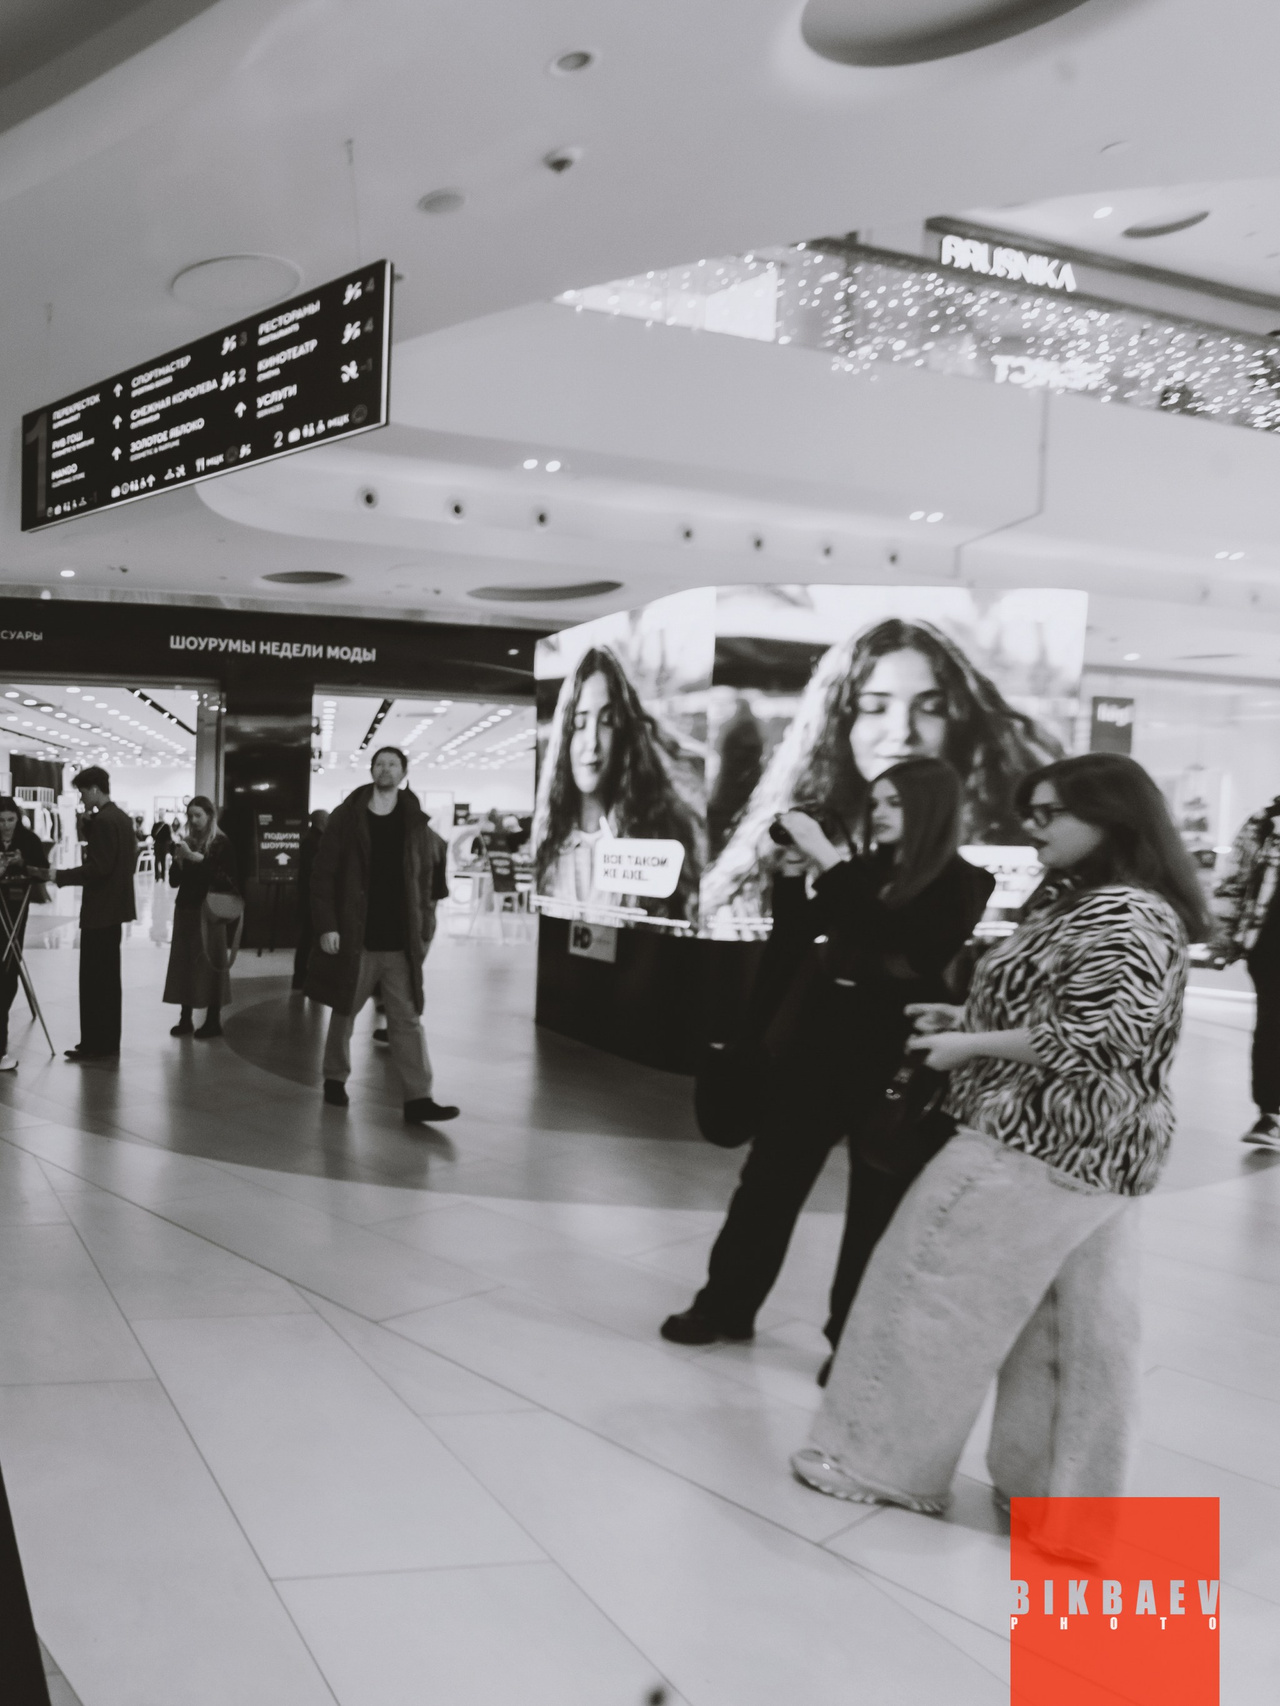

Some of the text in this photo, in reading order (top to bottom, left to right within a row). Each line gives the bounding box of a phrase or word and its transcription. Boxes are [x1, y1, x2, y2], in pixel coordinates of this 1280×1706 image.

[258, 300, 320, 335] РЕСТОРАНЫ
[257, 338, 318, 372] КИНОТЕАТР
[131, 355, 191, 388] СПОРТМАСТЕР
[238, 367, 246, 383] 2
[130, 396, 171, 420] СНЕЖНАЯ
[172, 378, 218, 405] КОРОЛЕВА
[256, 383, 297, 408] УСЛУГИ
[130, 430, 168, 453] ЗОЛОТОЕ
[169, 417, 205, 439] ЯБЛОКО
[273, 431, 283, 448] 2
[169, 635, 376, 663] ШОУРУМЫ НЕДЕЛИ МОДЫ
[263, 832, 300, 841] ПОДИУМ
